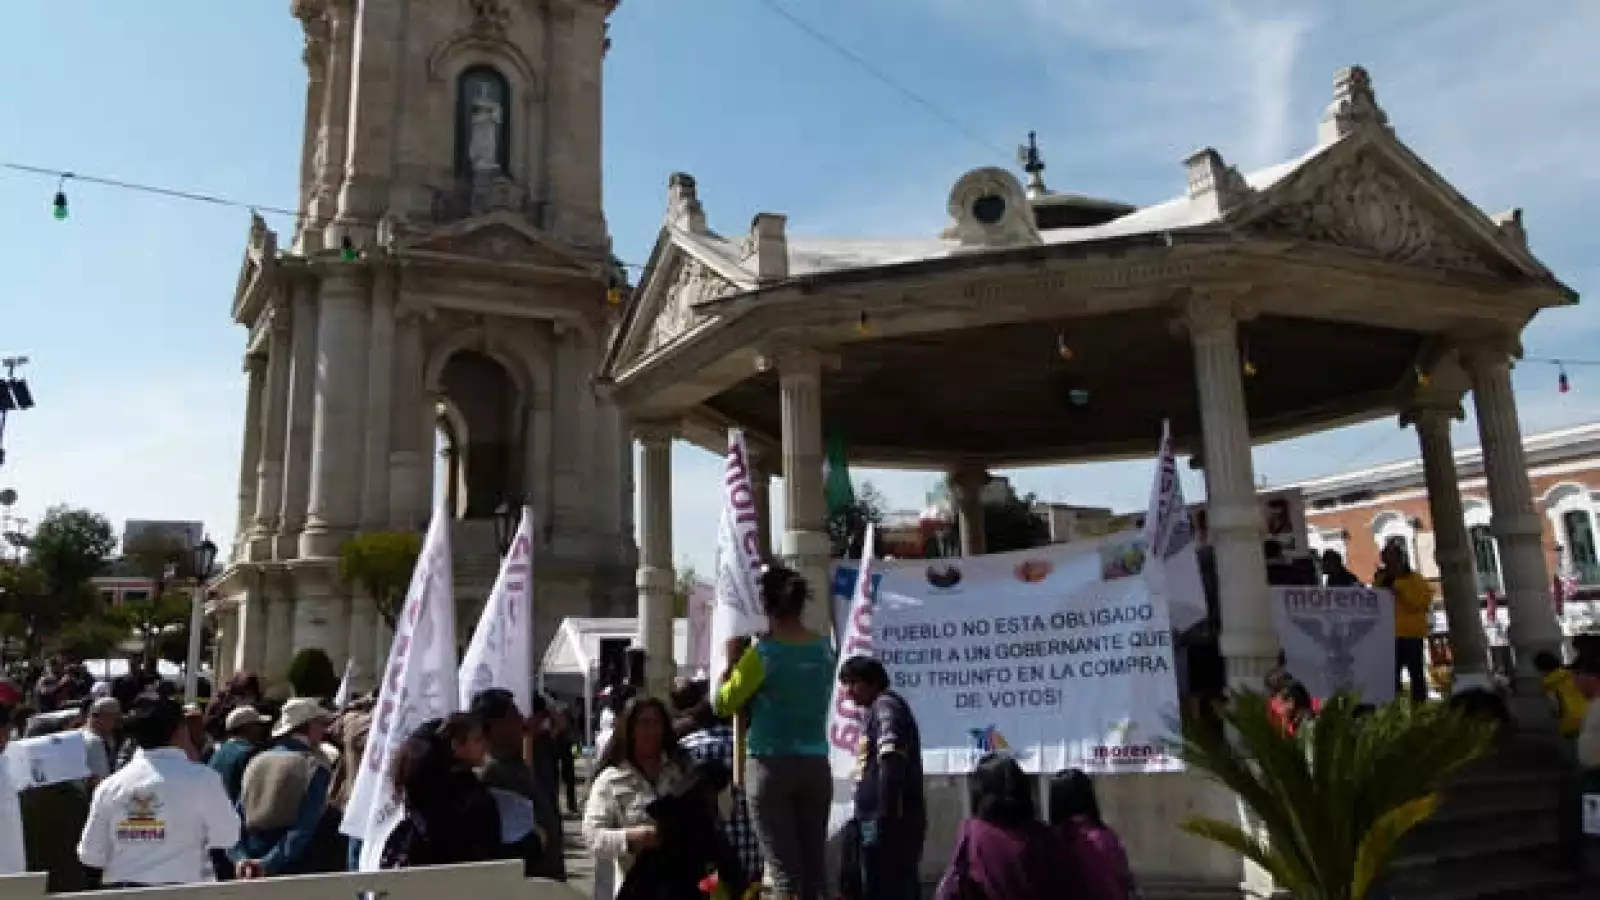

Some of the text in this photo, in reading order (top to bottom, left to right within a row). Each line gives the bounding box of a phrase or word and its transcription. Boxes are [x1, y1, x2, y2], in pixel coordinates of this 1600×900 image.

[1284, 588, 1379, 609] morena
[881, 604, 1154, 641] PUEBLO NO ESTA OBLIGADO
[948, 649, 960, 662] A
[963, 645, 991, 662] UN
[995, 632, 1126, 660] GOBERNANTE
[1127, 629, 1171, 647] QUE
[893, 655, 1170, 688] SU TRIUNFO EN LA COMPRA
[956, 692, 981, 708] DE
